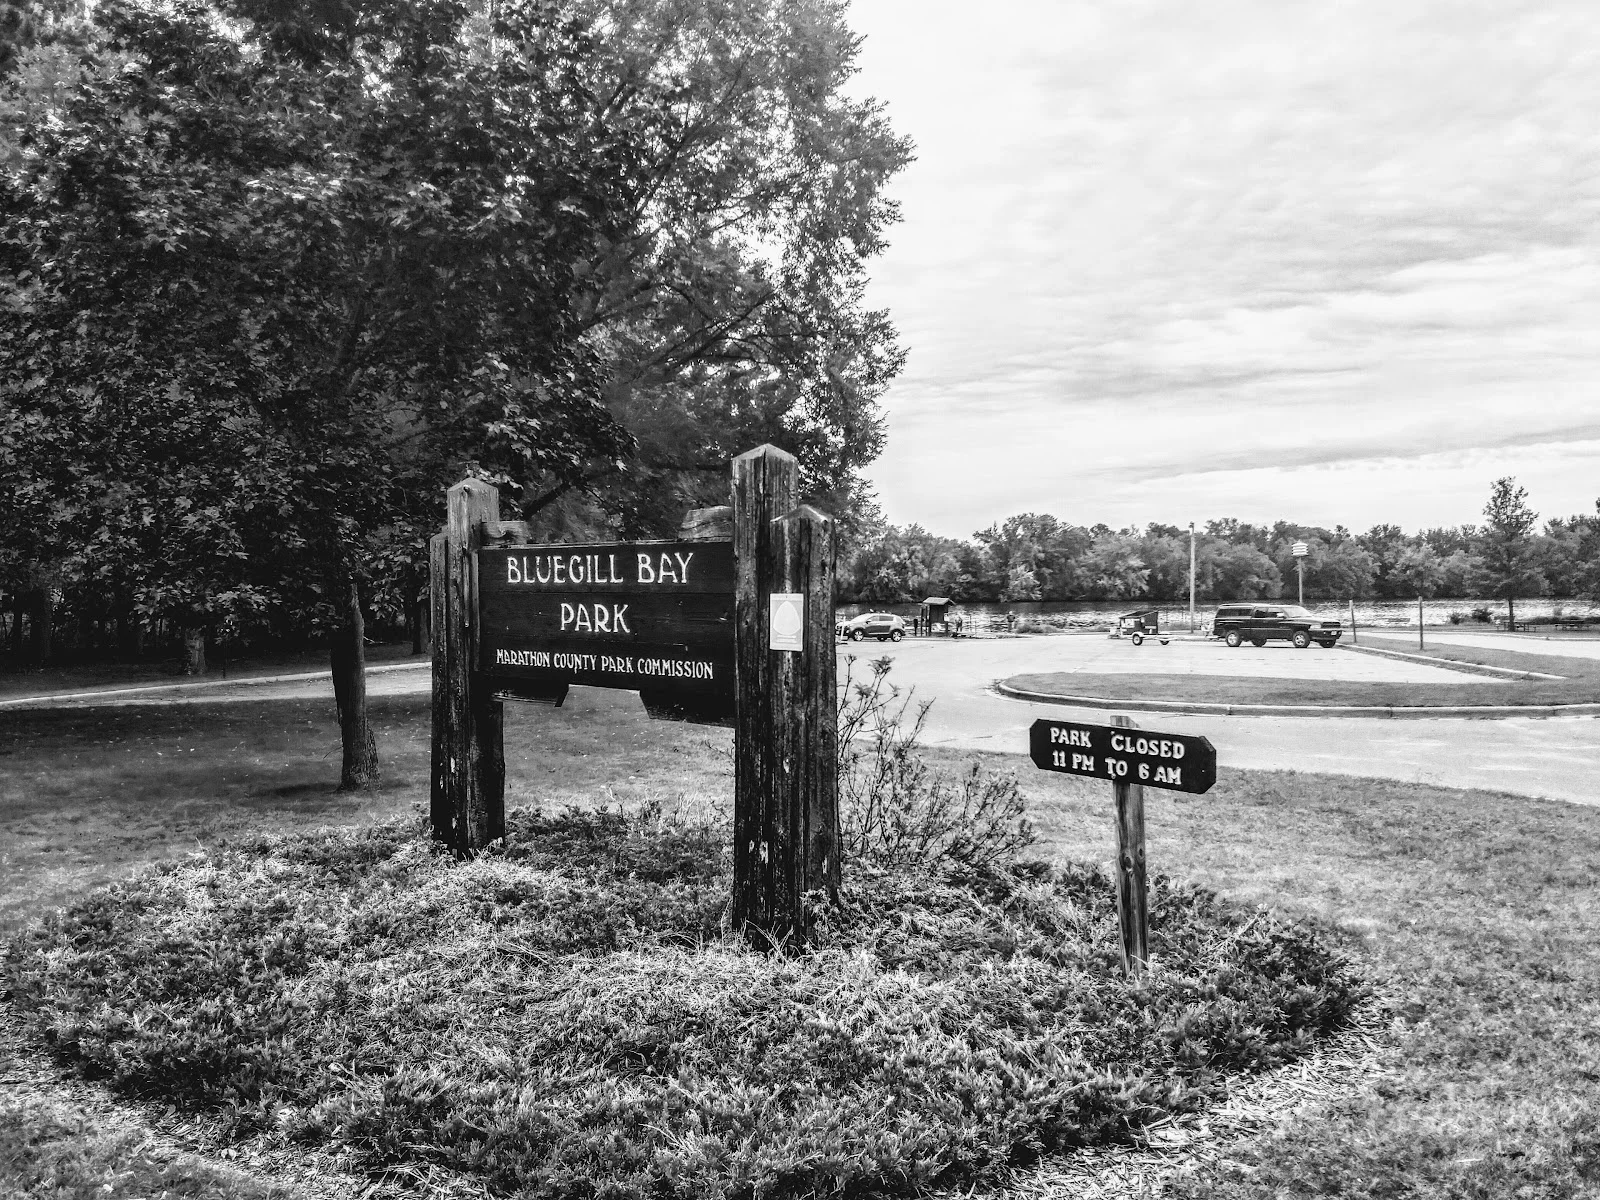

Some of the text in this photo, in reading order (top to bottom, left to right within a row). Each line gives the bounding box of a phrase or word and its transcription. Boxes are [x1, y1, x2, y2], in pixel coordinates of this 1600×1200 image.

[506, 552, 694, 584] BLUEGILL BAY
[560, 602, 631, 634] PARK
[496, 648, 714, 680] MARATHON COUNTY PARK COMMISSION
[1050, 727, 1185, 760] PARK CLOSED
[1052, 750, 1182, 785] 11 PM TO 6 AM
